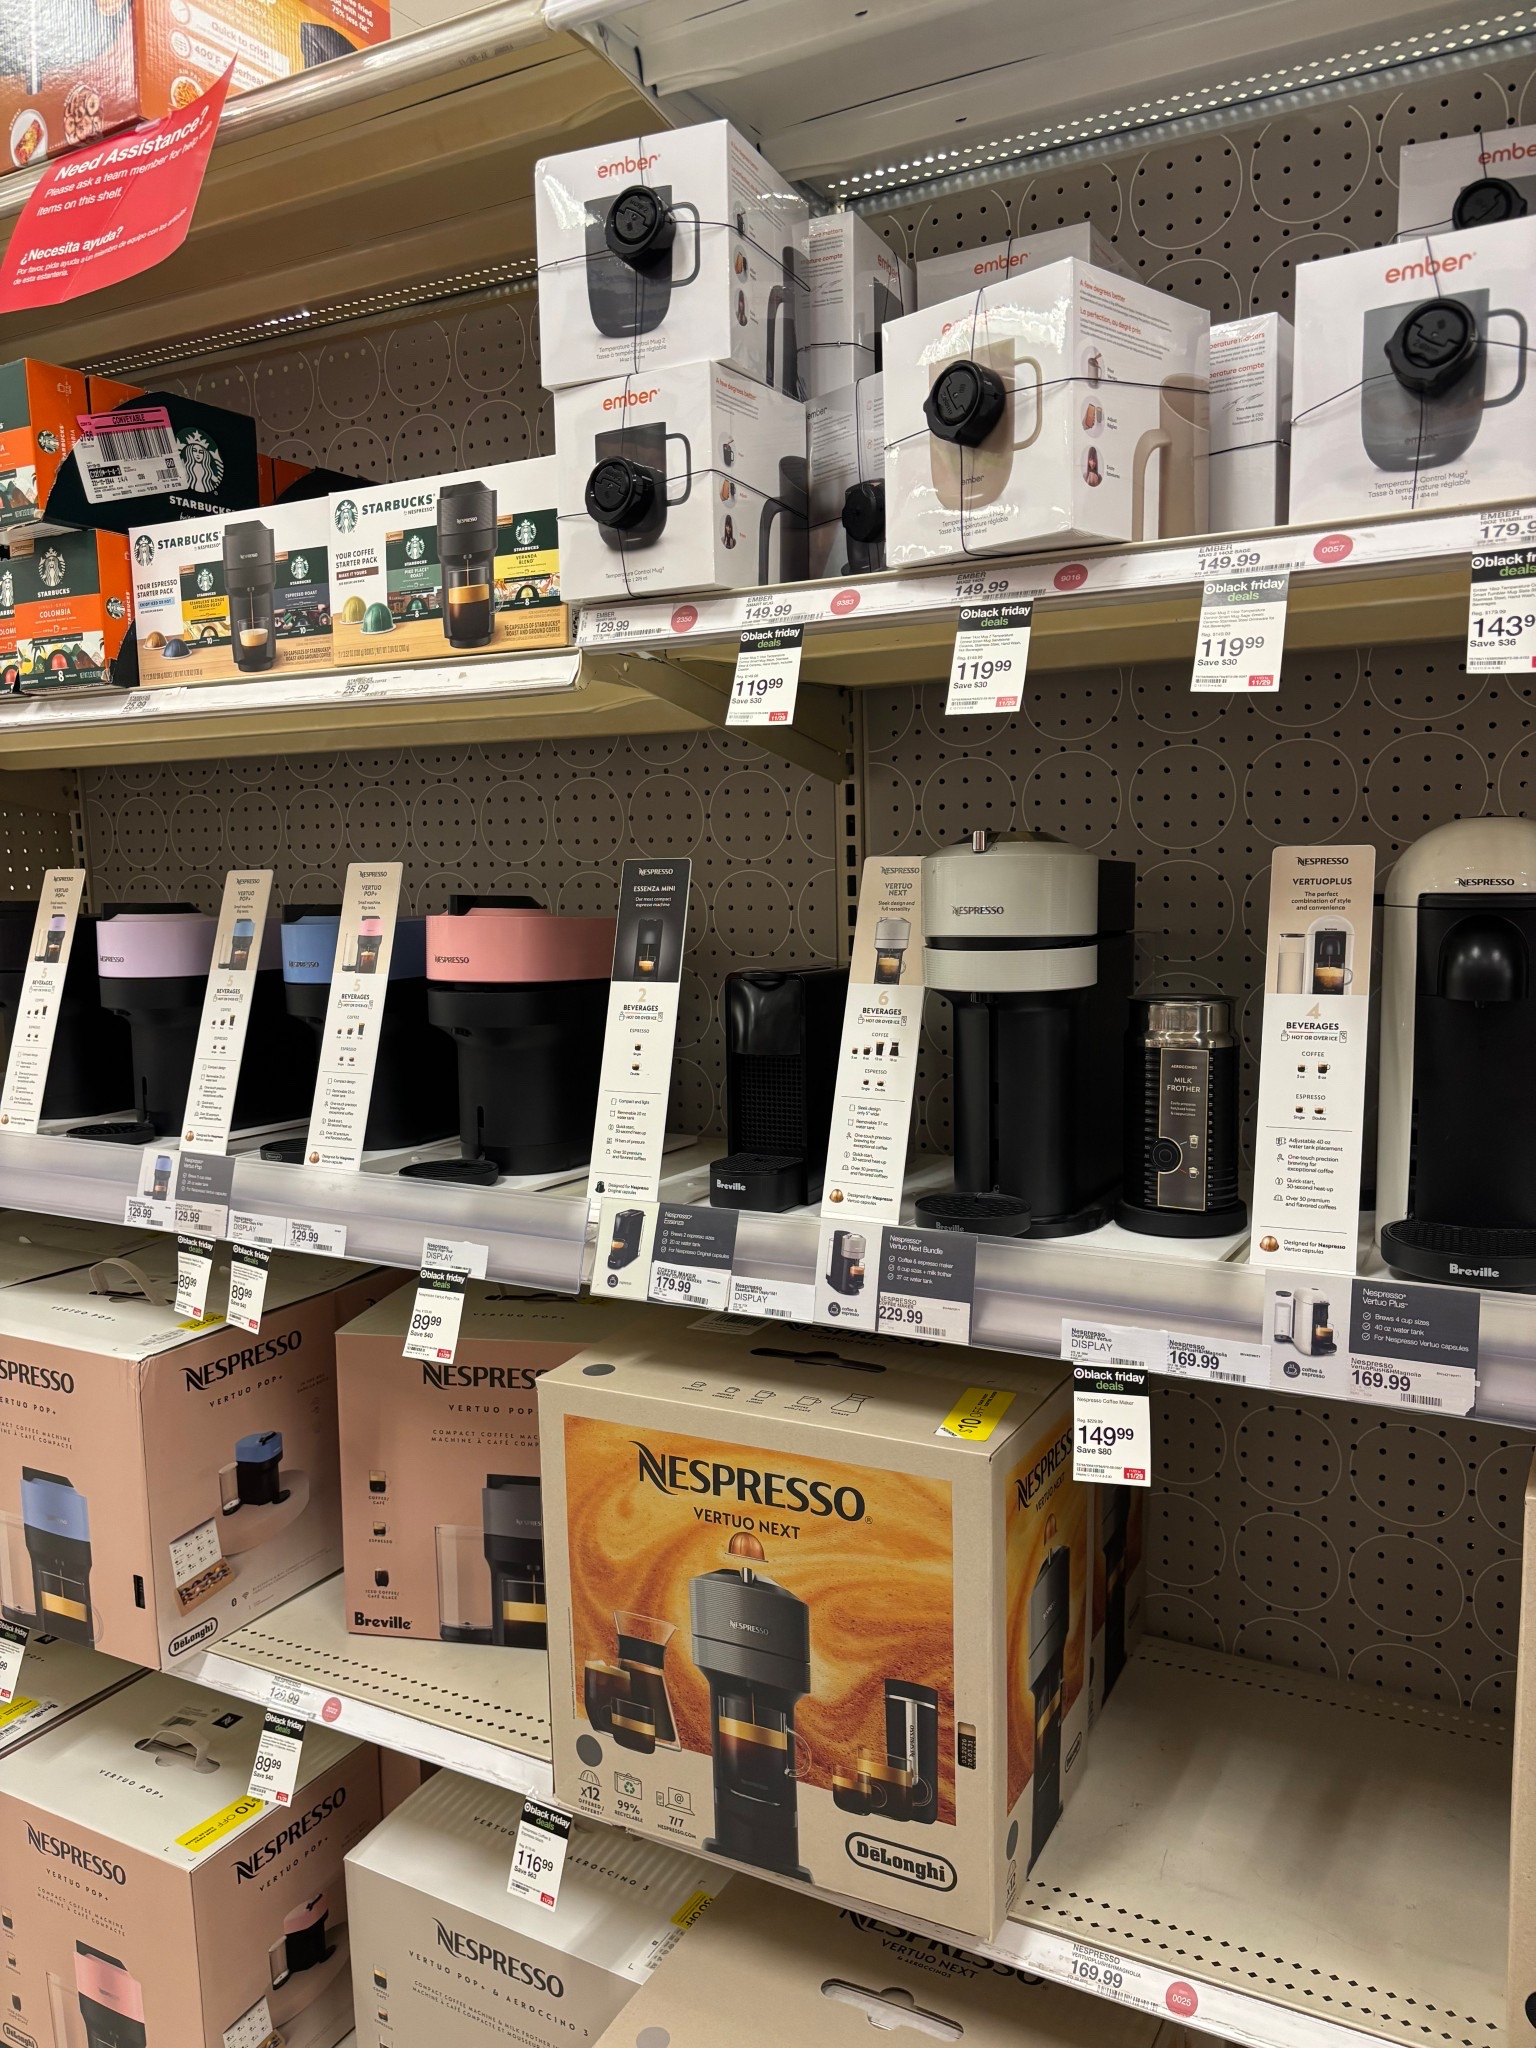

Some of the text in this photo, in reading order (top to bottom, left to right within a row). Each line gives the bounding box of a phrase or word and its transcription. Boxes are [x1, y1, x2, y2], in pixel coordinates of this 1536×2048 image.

[249, 40, 270, 59] crisp
[54, 105, 210, 182] Need Assistance?
[597, 153, 658, 179] ember
[44, 157, 166, 199] Please ask team member
[37, 193, 95, 217] items on this
[20, 226, 124, 266] ¿Necesita ayuda?
[60, 257, 80, 268] ayuda
[973, 253, 1029, 275] ember
[1384, 252, 1472, 284] ember
[1094, 285, 1111, 298] degrees
[1238, 362, 1265, 373] compte
[602, 389, 659, 411] ember
[112, 414, 145, 424] CONVEYABLE
[1419, 474, 1447, 483] Control
[361, 493, 433, 516] STARBUCKS
[157, 531, 220, 549] STARBUCKS
[335, 548, 375, 560] YOUR COFFEE
[1321, 544, 1345, 554] 0057
[335, 556, 378, 569] STARTER PACK
[1198, 552, 1261, 571] 149.99
[1484, 553, 1523, 568] black
[151, 579, 178, 589] ESPRESSO
[954, 580, 1009, 597] 149.99
[1216, 578, 1285, 593] black friday
[37, 588, 71, 598] STARBUCKS
[137, 587, 174, 599] STARTER PACK
[1227, 591, 1260, 602] deals
[745, 604, 792, 620] 149.99
[970, 605, 1031, 619] black friday
[595, 620, 630, 633] 129.99
[980, 616, 1009, 627] deals
[749, 627, 800, 641] black friday
[757, 638, 781, 649] deals
[1498, 638, 1516, 646] $36
[1197, 658, 1237, 667] Save $30
[953, 680, 988, 690] Save $30
[1296, 856, 1349, 866] NESPRESSO
[359, 870, 387, 878] NESPRESSO
[638, 867, 674, 877] NESPRESSO
[880, 866, 920, 876] NESPRESSO
[236, 878, 260, 886] NESPRESSO
[1292, 877, 1352, 886] VERTUOPLUS
[1456, 877, 1515, 887] NESPRESSO
[951, 904, 1005, 916] NESPRESSO
[638, 988, 647, 1003] 2
[878, 991, 889, 1006] 6
[623, 1004, 659, 1012] BEVERAGES
[862, 1007, 902, 1016] BEVERAGES
[1305, 1002, 1322, 1020] 4
[1286, 1022, 1339, 1031] BEVERAGES
[1174, 1076, 1192, 1084] MILK
[1166, 1084, 1201, 1093] FROTHER
[1295, 1093, 1326, 1101] ESPRESSO
[716, 1178, 747, 1191] Breville
[128, 1206, 152, 1219] 129.99
[233, 1223, 257, 1233] DISPLAY
[663, 1218, 685, 1226] Essenza
[291, 1229, 319, 1243] 129.99
[908, 1244, 922, 1252] Next
[426, 1251, 454, 1262] DISPLAY
[426, 1269, 466, 1284] black friday
[1449, 1263, 1500, 1278] Breville
[656, 1277, 691, 1294] 179.99
[734, 1293, 768, 1304] DISPLAY
[1362, 1296, 1388, 1308] Vertuo
[879, 1305, 923, 1324] 229.99
[1374, 1313, 1430, 1326] Brews sizes
[1071, 1338, 1114, 1353] DISPLAY
[1169, 1339, 1206, 1350] Nespresso
[1373, 1333, 1470, 1353] For Nespresso Vertuo capsules
[179, 1329, 303, 1392] NESPRESSO
[1169, 1350, 1220, 1370] 169.99
[1351, 1357, 1394, 1369] Nespresso
[1084, 1369, 1145, 1384] black friday
[1351, 1369, 1411, 1392] 169.99
[1096, 1381, 1124, 1391] deals
[209, 1386, 251, 1408] VERTUO
[448, 1404, 501, 1414] VERTUO
[431, 1436, 472, 1445] MACHINE
[432, 1429, 516, 1439] COMPACT COFFEE
[1076, 1446, 1112, 1456] Save $80
[1125, 1472, 1144, 1480] 11/29
[693, 1506, 801, 1541] VERTUO NEXT
[354, 1611, 411, 1631] Breville
[729, 1619, 770, 1637] NESPRESSO
[14, 1625, 28, 1639] friday
[270, 1712, 287, 1725] black
[98, 1768, 137, 1786] VERTUO
[580, 1786, 601, 1802] x12
[616, 1799, 641, 1816] 99%
[530, 1804, 571, 1830] black friday
[231, 1786, 347, 1885] NESPRESSO
[657, 1823, 697, 1840] NESPRESSO.COM
[22, 1819, 127, 1886] NESPRESSO
[46, 1868, 82, 1890] VERTUO
[259, 1859, 300, 1892] VERTUO
[37, 1886, 125, 1930] COMPACT MACHINE
[432, 1917, 565, 1999] NESPRESSO
[881, 1937, 978, 1980] VERTUO NEXT
[1072, 1943, 1121, 1965] NESPRESSO
[1071, 1959, 1123, 1989] 169.99
[408, 1950, 576, 2032] VERTUO AEROCCINO
[414, 1979, 497, 2022] COMPACT COFFEE MACHINE
[1171, 1993, 1193, 2009] 0025
